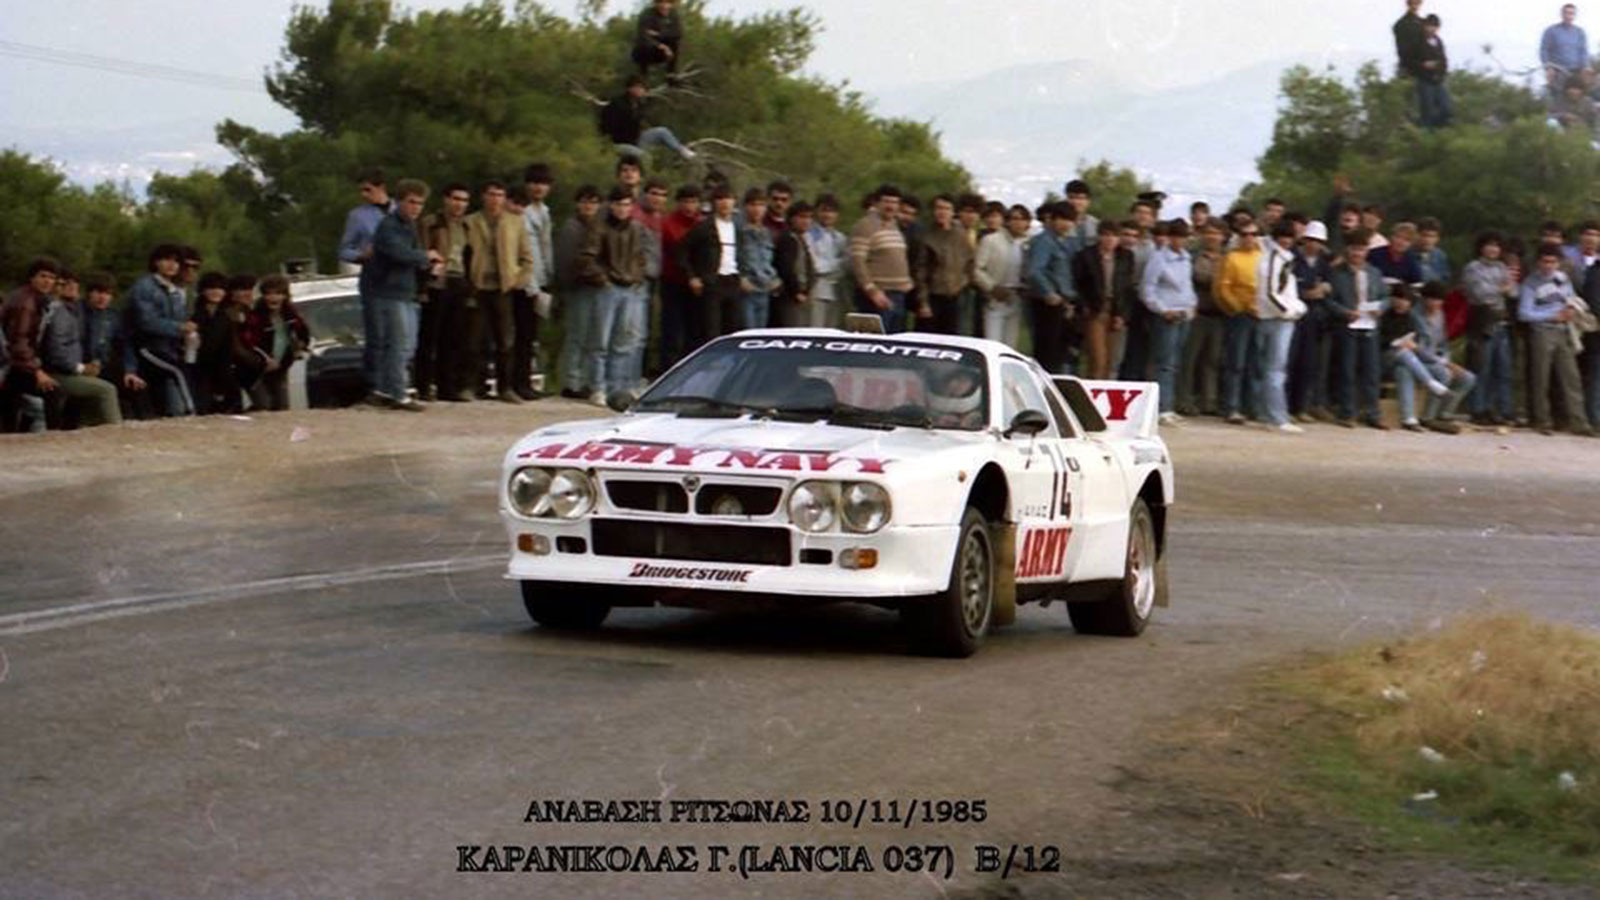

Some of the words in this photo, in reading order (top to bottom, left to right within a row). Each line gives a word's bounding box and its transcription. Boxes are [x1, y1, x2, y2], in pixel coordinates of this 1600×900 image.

[517, 441, 712, 466] ARMY
[716, 448, 896, 474] NAVY
[1014, 527, 1073, 578] ARMY
